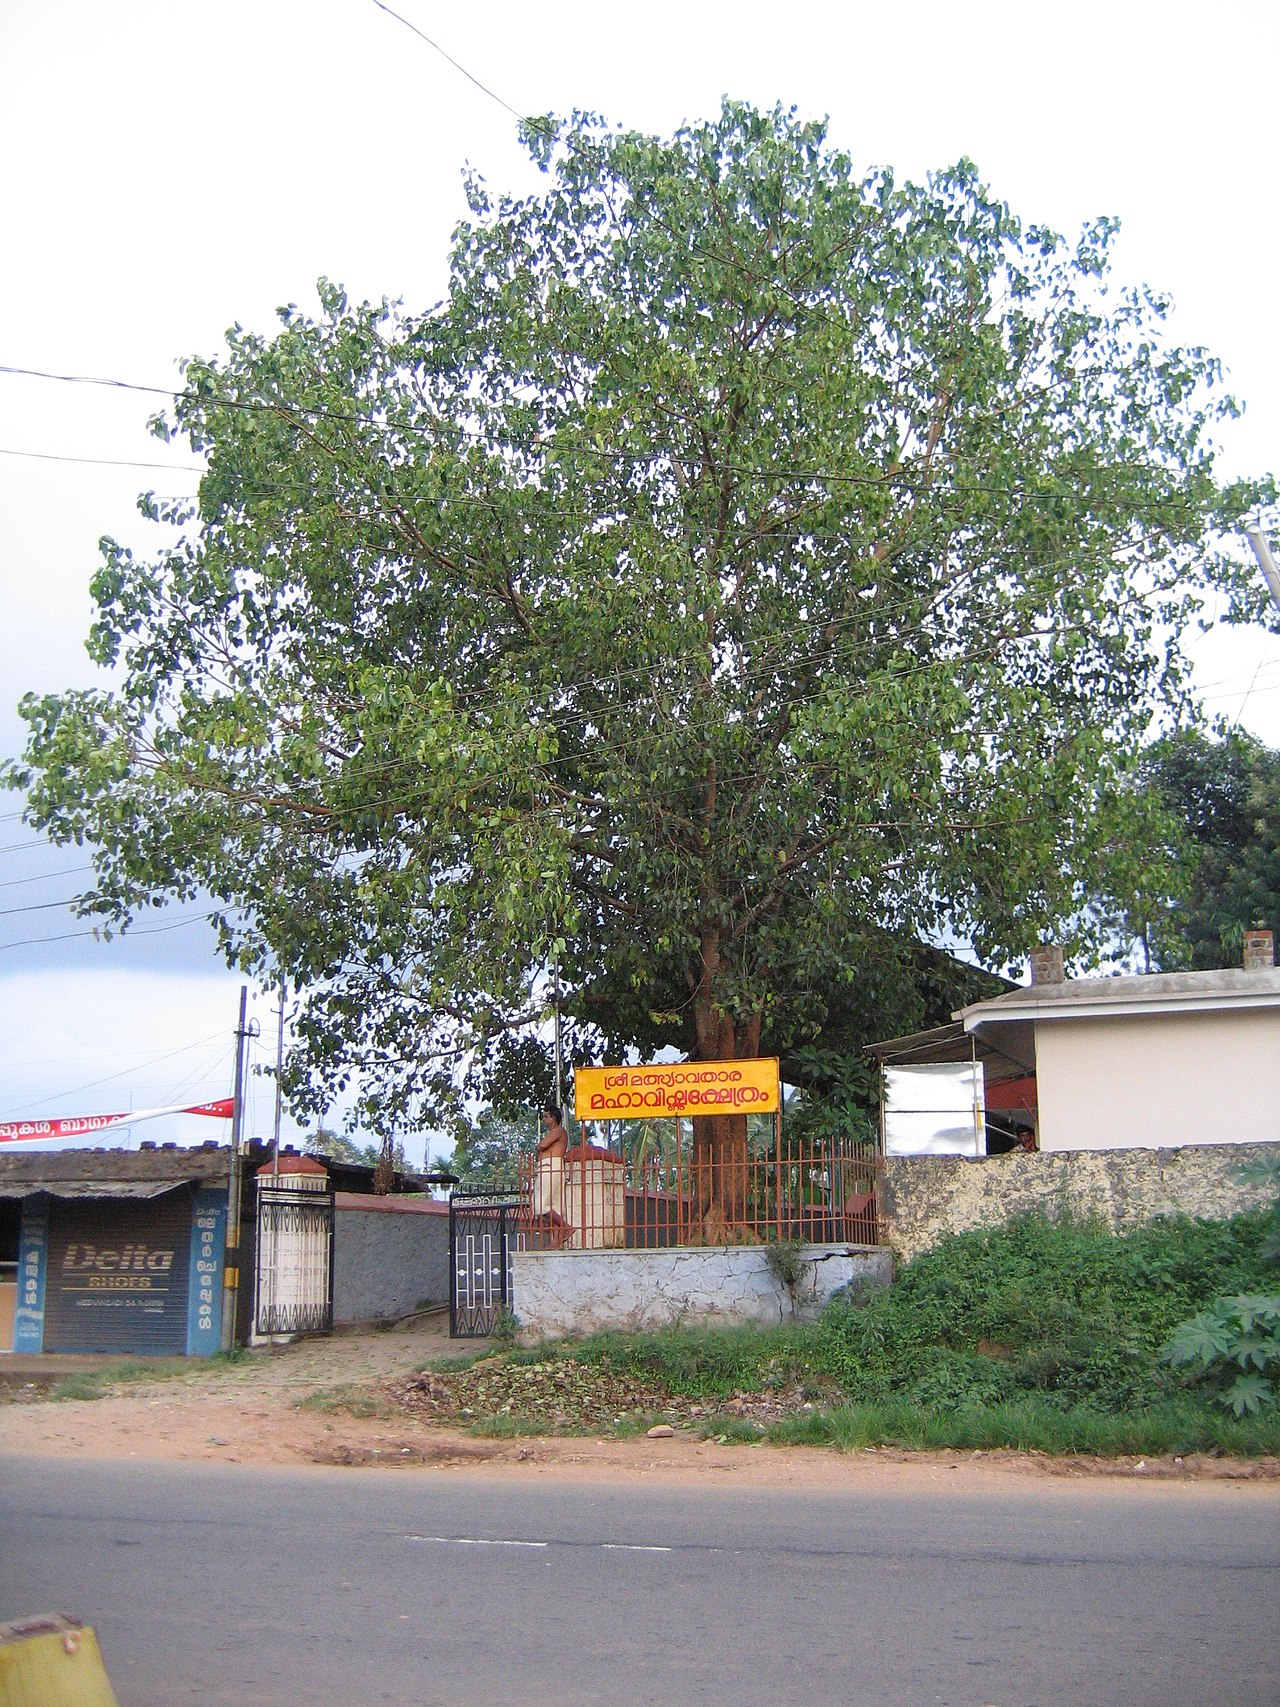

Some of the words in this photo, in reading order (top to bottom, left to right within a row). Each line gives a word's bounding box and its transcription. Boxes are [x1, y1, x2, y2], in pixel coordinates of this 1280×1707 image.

[604, 1072, 628, 1090] ശ്രീ
[630, 1070, 742, 1088] മത്സ്യാവതാര
[63, 1245, 174, 1270] Delta
